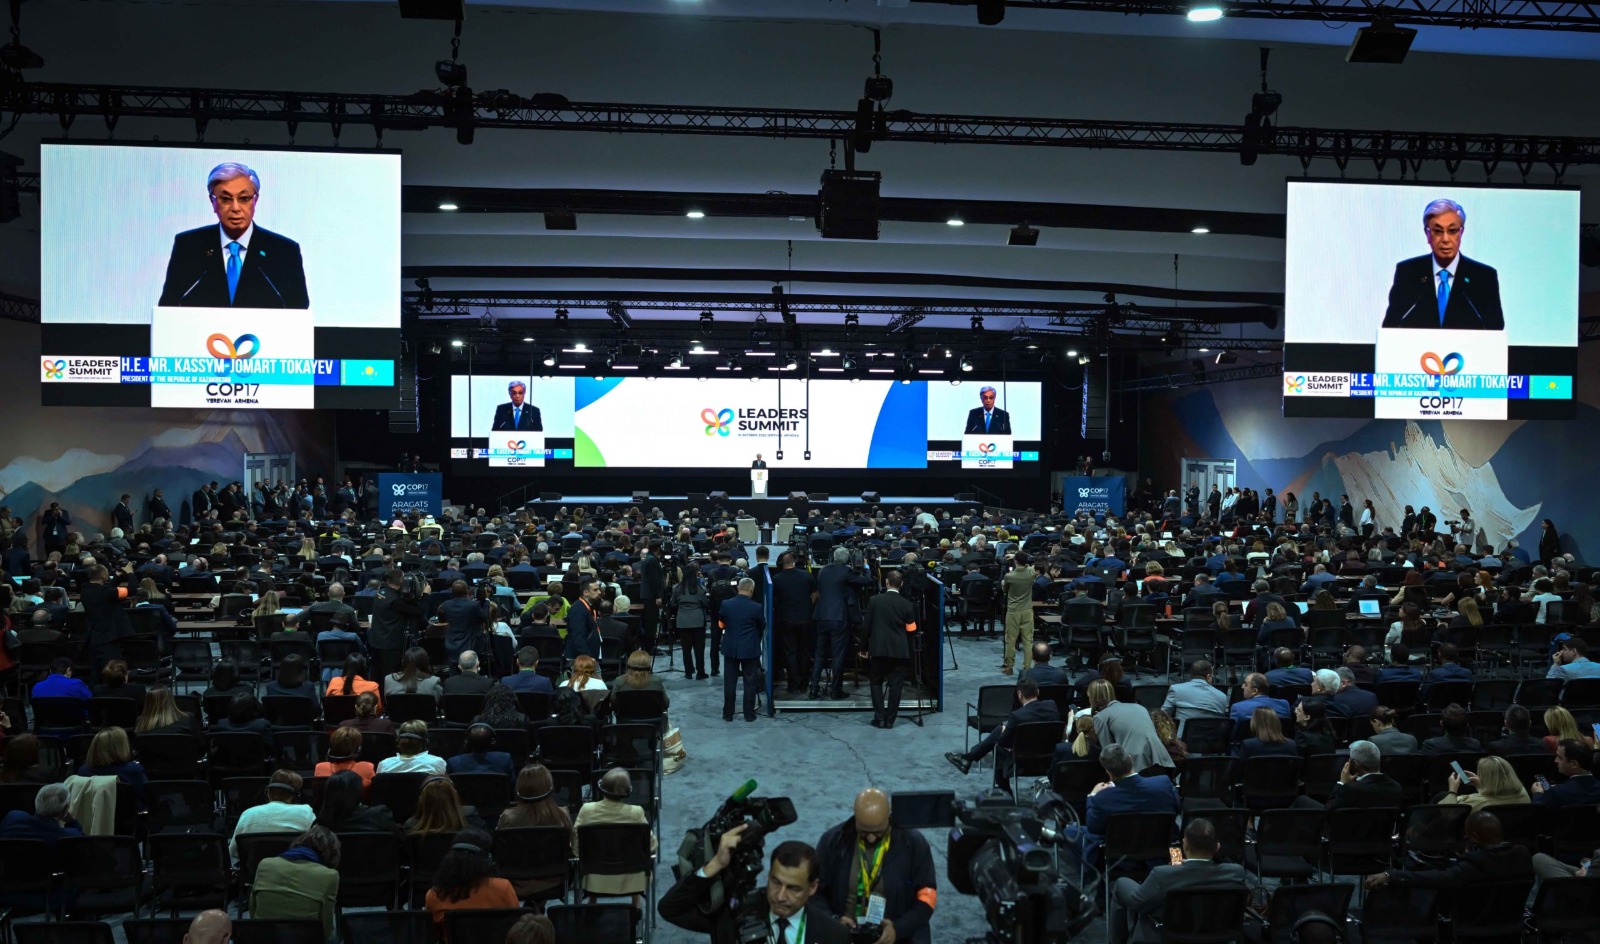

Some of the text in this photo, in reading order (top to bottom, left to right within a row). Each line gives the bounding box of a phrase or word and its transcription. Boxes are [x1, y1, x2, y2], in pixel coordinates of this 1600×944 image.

[122, 358, 333, 374] H.E. MR. KASSYM-JOMART TOKAYEV
[1350, 374, 1523, 389] H.E. MR. KASSYM-JOMART TOKAYEV
[206, 383, 260, 396] COP17
[1420, 397, 1463, 408] COP17
[738, 408, 808, 419] LEADERS
[738, 421, 799, 431] SUMMIT
